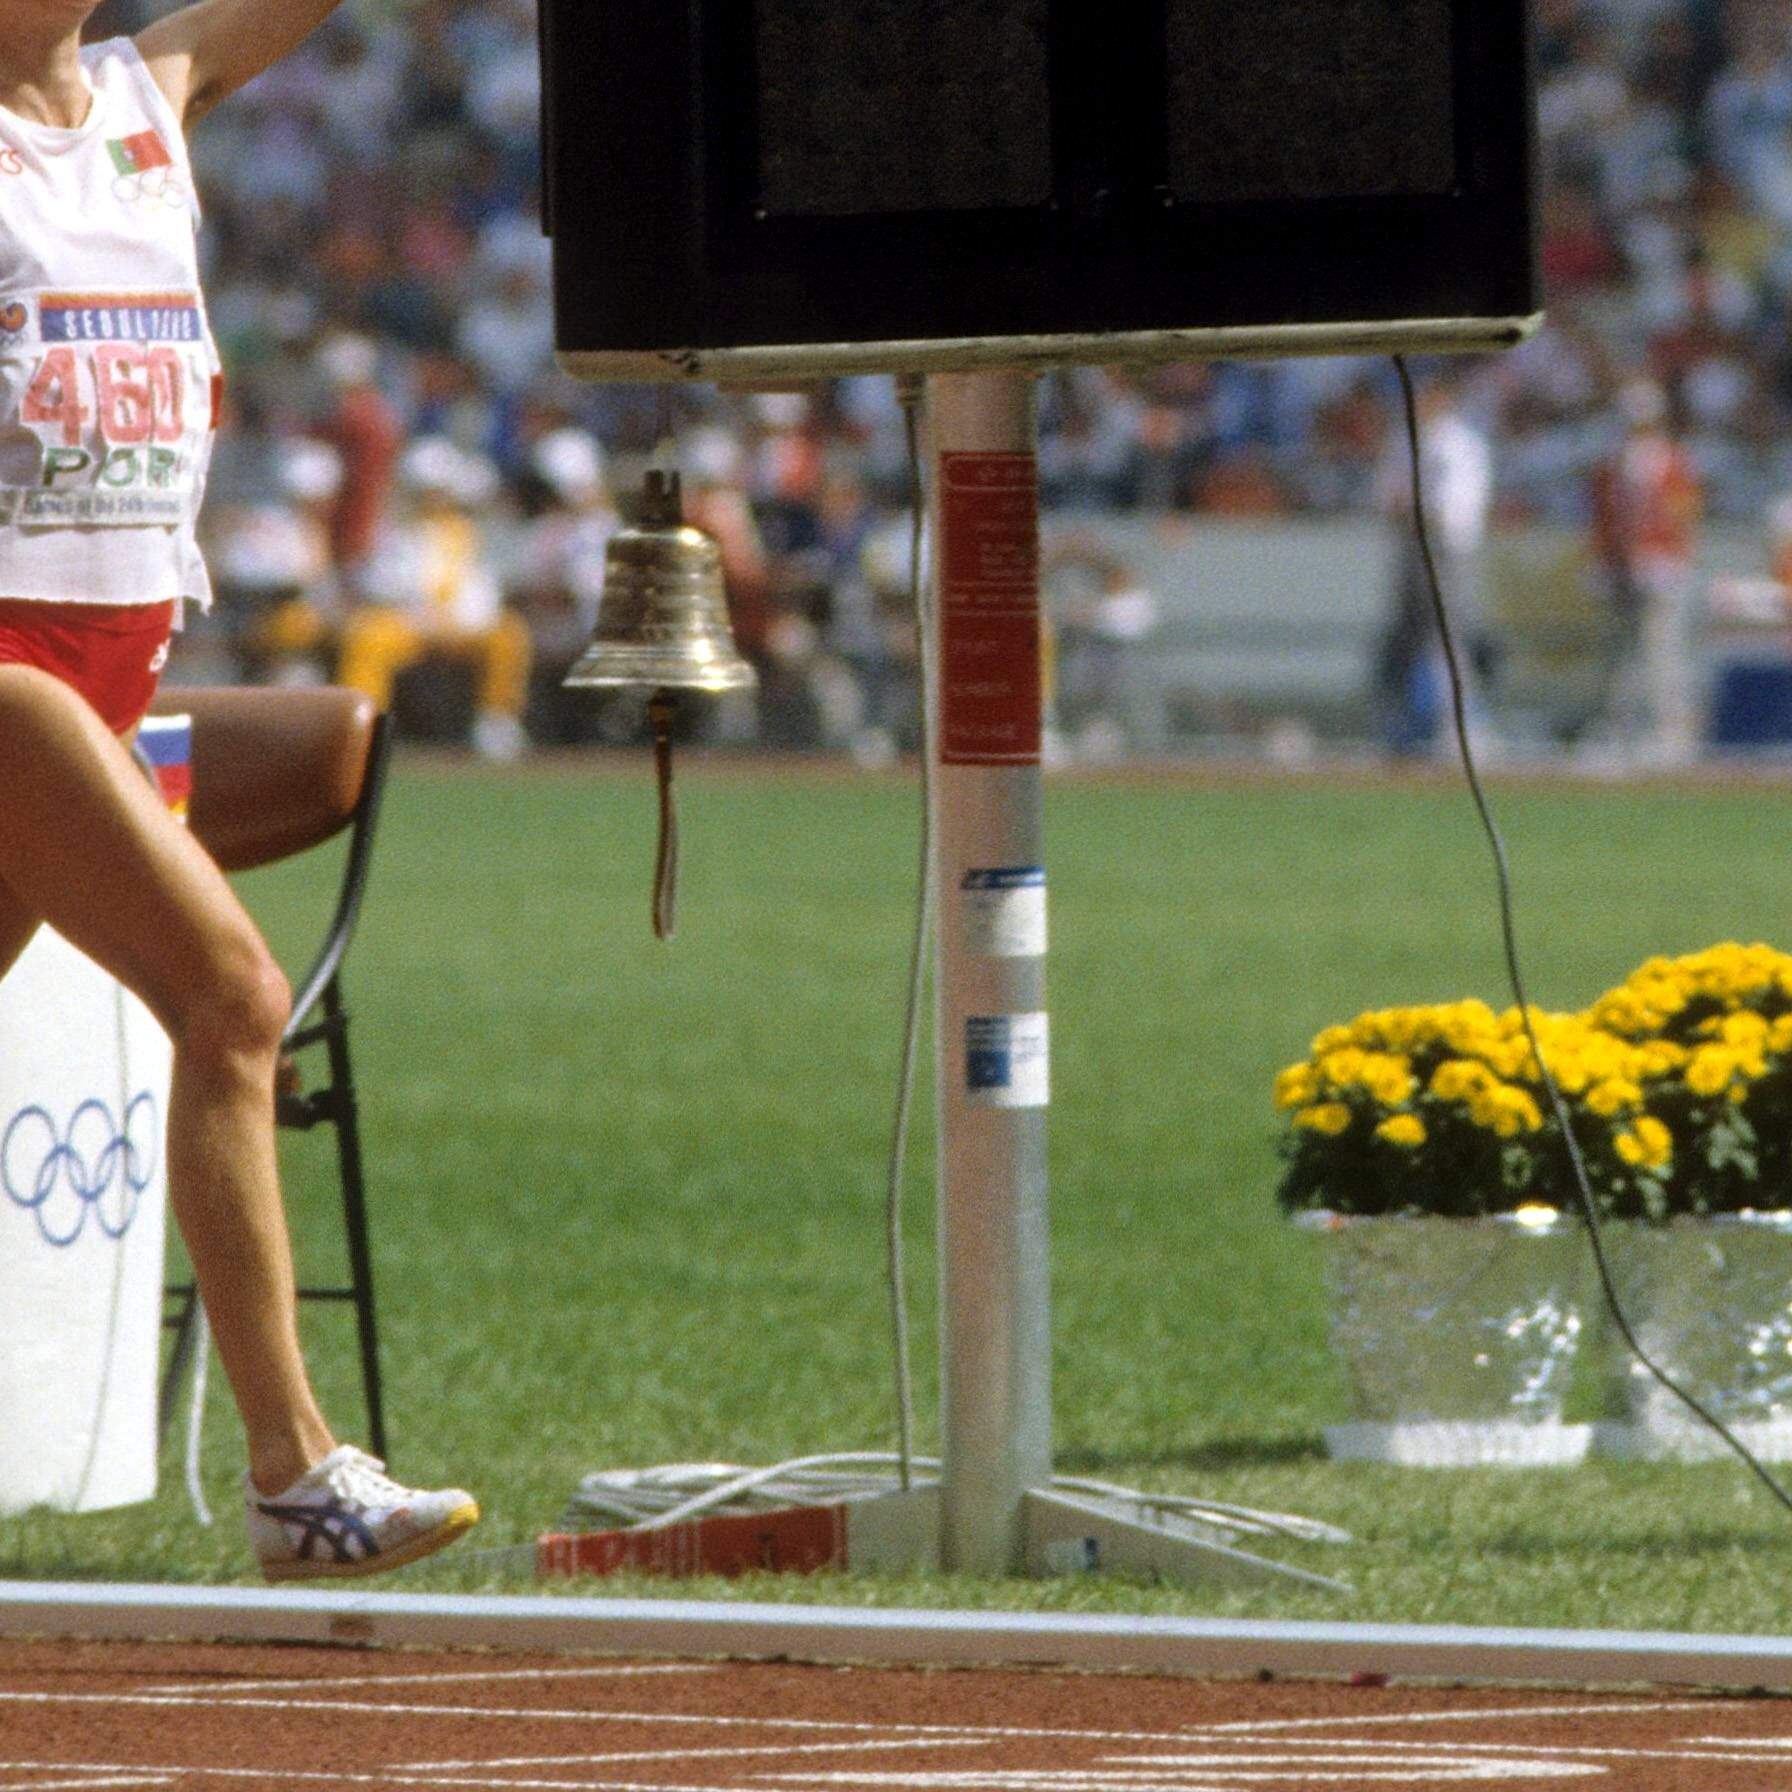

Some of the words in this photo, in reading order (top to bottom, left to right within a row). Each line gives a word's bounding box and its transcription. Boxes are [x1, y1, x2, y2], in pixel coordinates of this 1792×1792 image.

[64, 309, 147, 339] SEOUL
[21, 345, 184, 446] 460
[41, 447, 175, 487] POR
